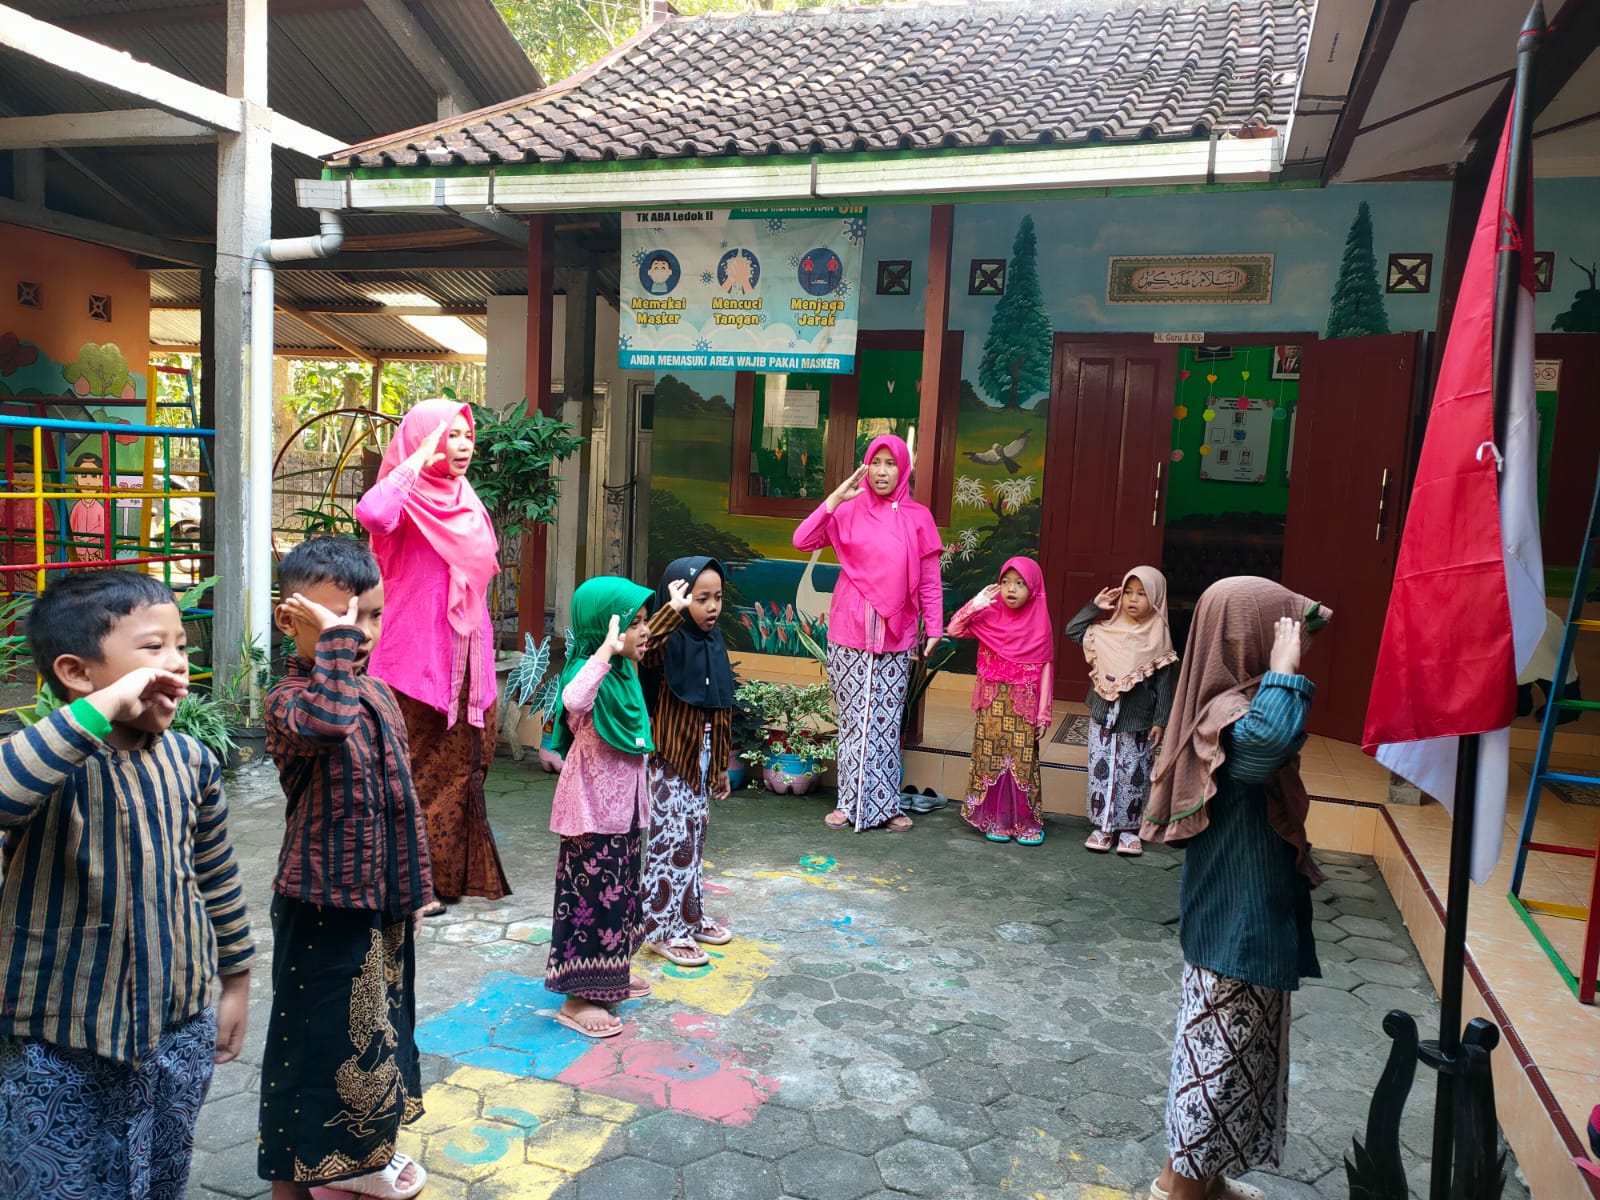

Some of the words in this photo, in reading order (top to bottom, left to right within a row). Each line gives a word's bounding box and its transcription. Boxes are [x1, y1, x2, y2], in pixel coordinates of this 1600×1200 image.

[636, 212, 649, 222] TK
[650, 212, 670, 222] ABA
[672, 211, 703, 222] Ledok
[631, 297, 687, 310] Memakai
[711, 297, 763, 310] Mencuci
[790, 298, 845, 316] Menjaga
[636, 312, 681, 325] Masker
[713, 312, 760, 329] Tangan
[797, 312, 836, 327] Jarak
[630, 354, 656, 366] ANDA
[658, 354, 708, 367] MEMASUKI
[709, 355, 735, 367] AREA
[736, 356, 767, 368] WAJIB
[768, 357, 799, 369] PAKAI
[800, 358, 840, 370] MASKER
[443, 1105, 541, 1166] 3
